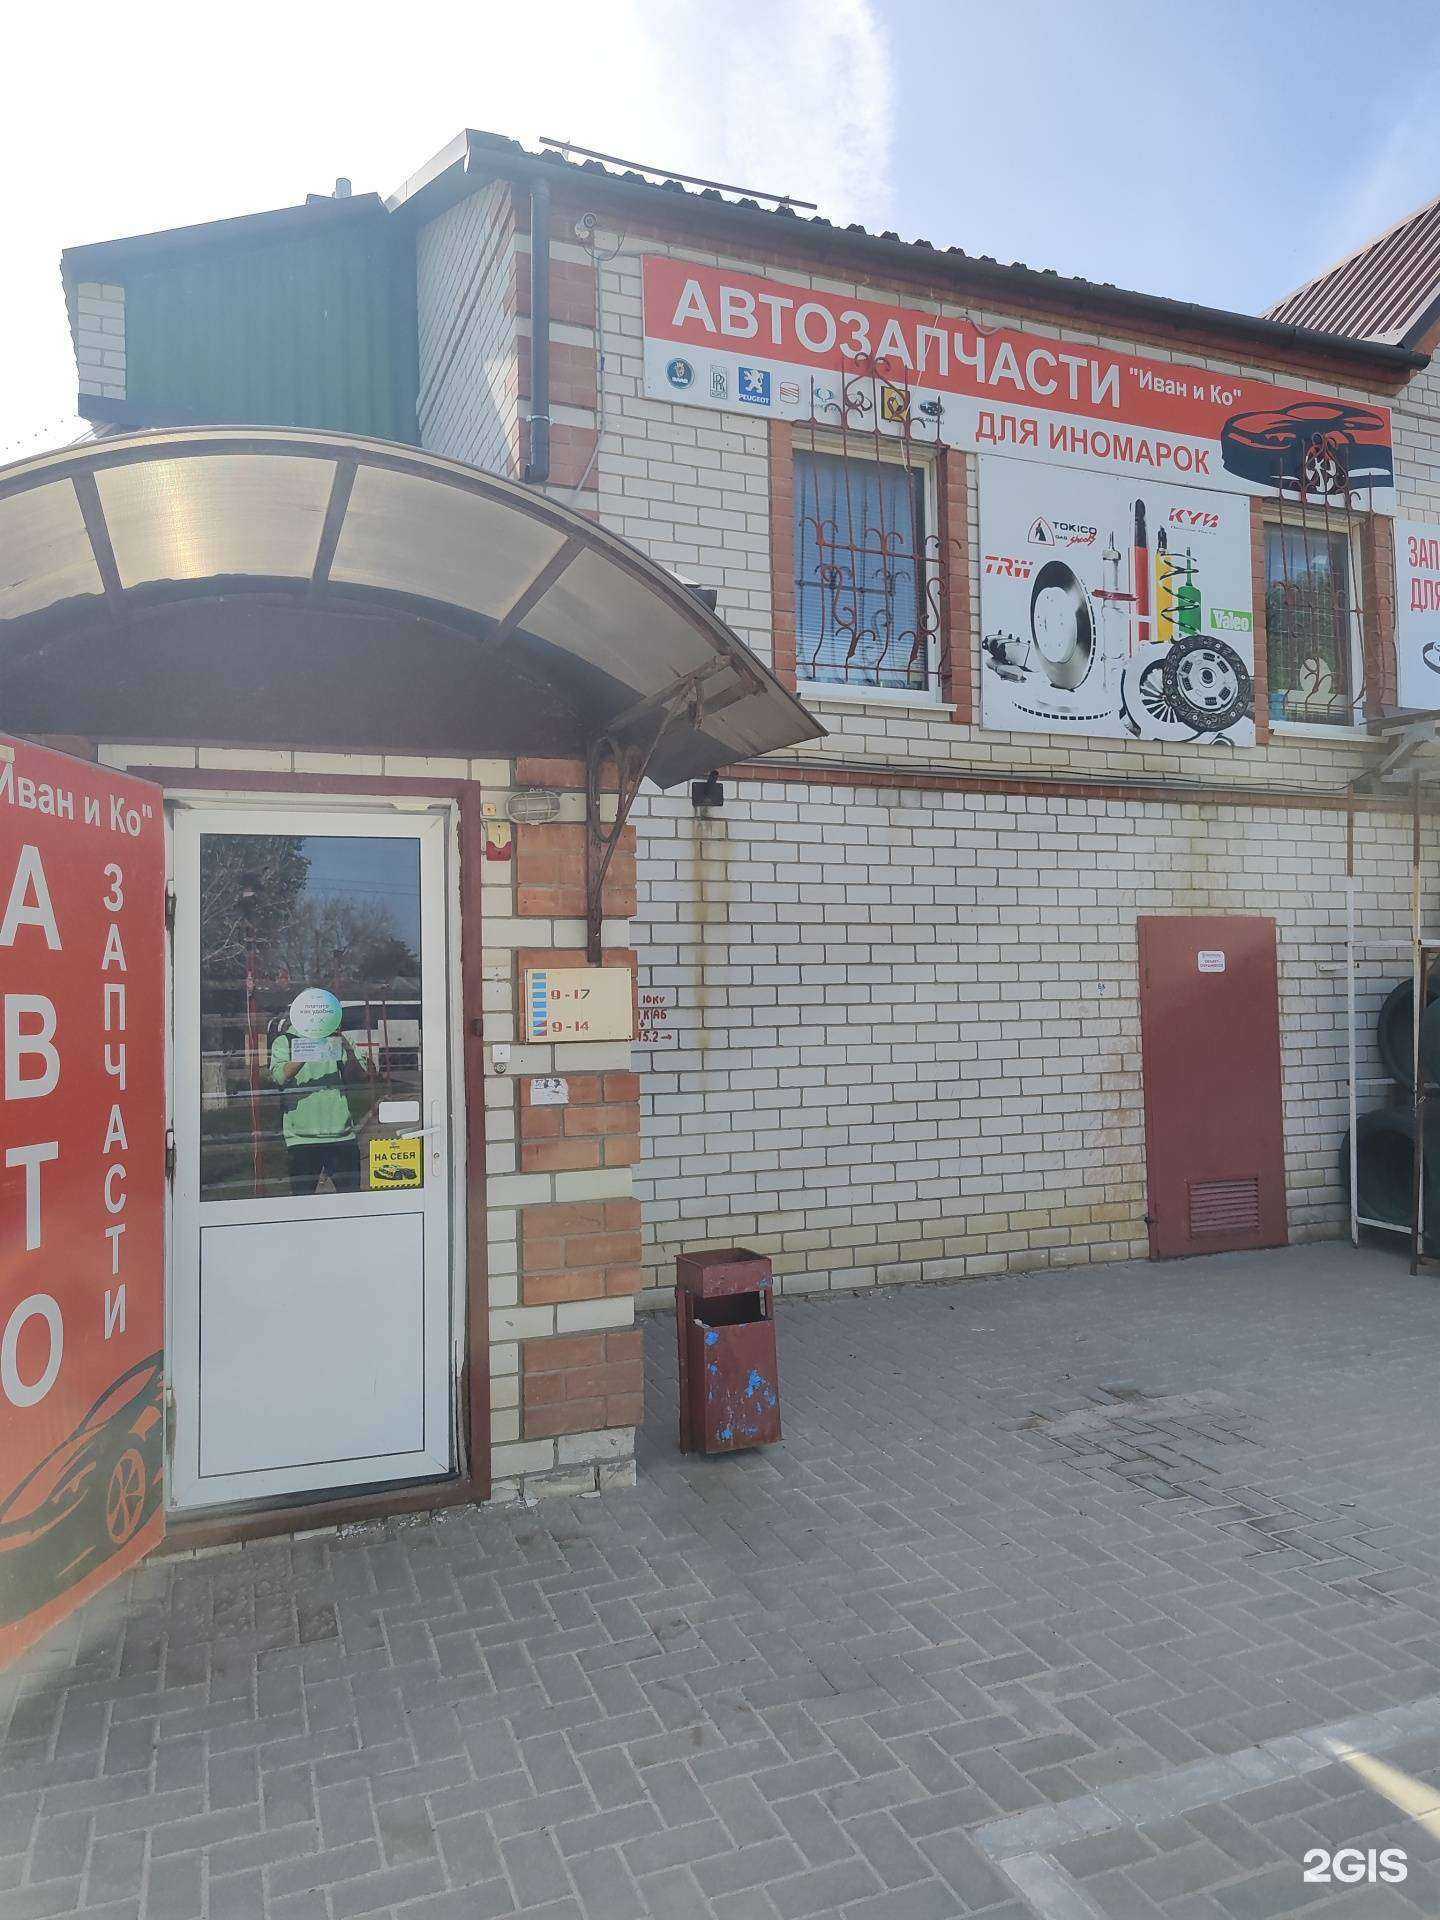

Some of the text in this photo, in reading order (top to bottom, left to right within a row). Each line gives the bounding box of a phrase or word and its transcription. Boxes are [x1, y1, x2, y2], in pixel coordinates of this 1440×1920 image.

[671, 279, 1120, 408] АВТОЗАПЧАСТИ
[1129, 367, 1188, 397] "Иван
[1193, 385, 1205, 401] и
[1210, 384, 1242, 406] Ко"
[737, 393, 771, 405] PEUGEOT
[975, 411, 1210, 475] ДЛЯ ИНОМАРОК
[1052, 521, 1098, 535] TOKICO
[1169, 508, 1219, 528] KYB
[984, 555, 1034, 579] TRW
[1212, 609, 1250, 631] Valeo
[84, 796, 101, 827] и
[109, 795, 153, 837] Ко"
[101, 863, 129, 1341] ЗАПЧАСТИ
[374, 1151, 416, 1162] НА СЕБЯ
